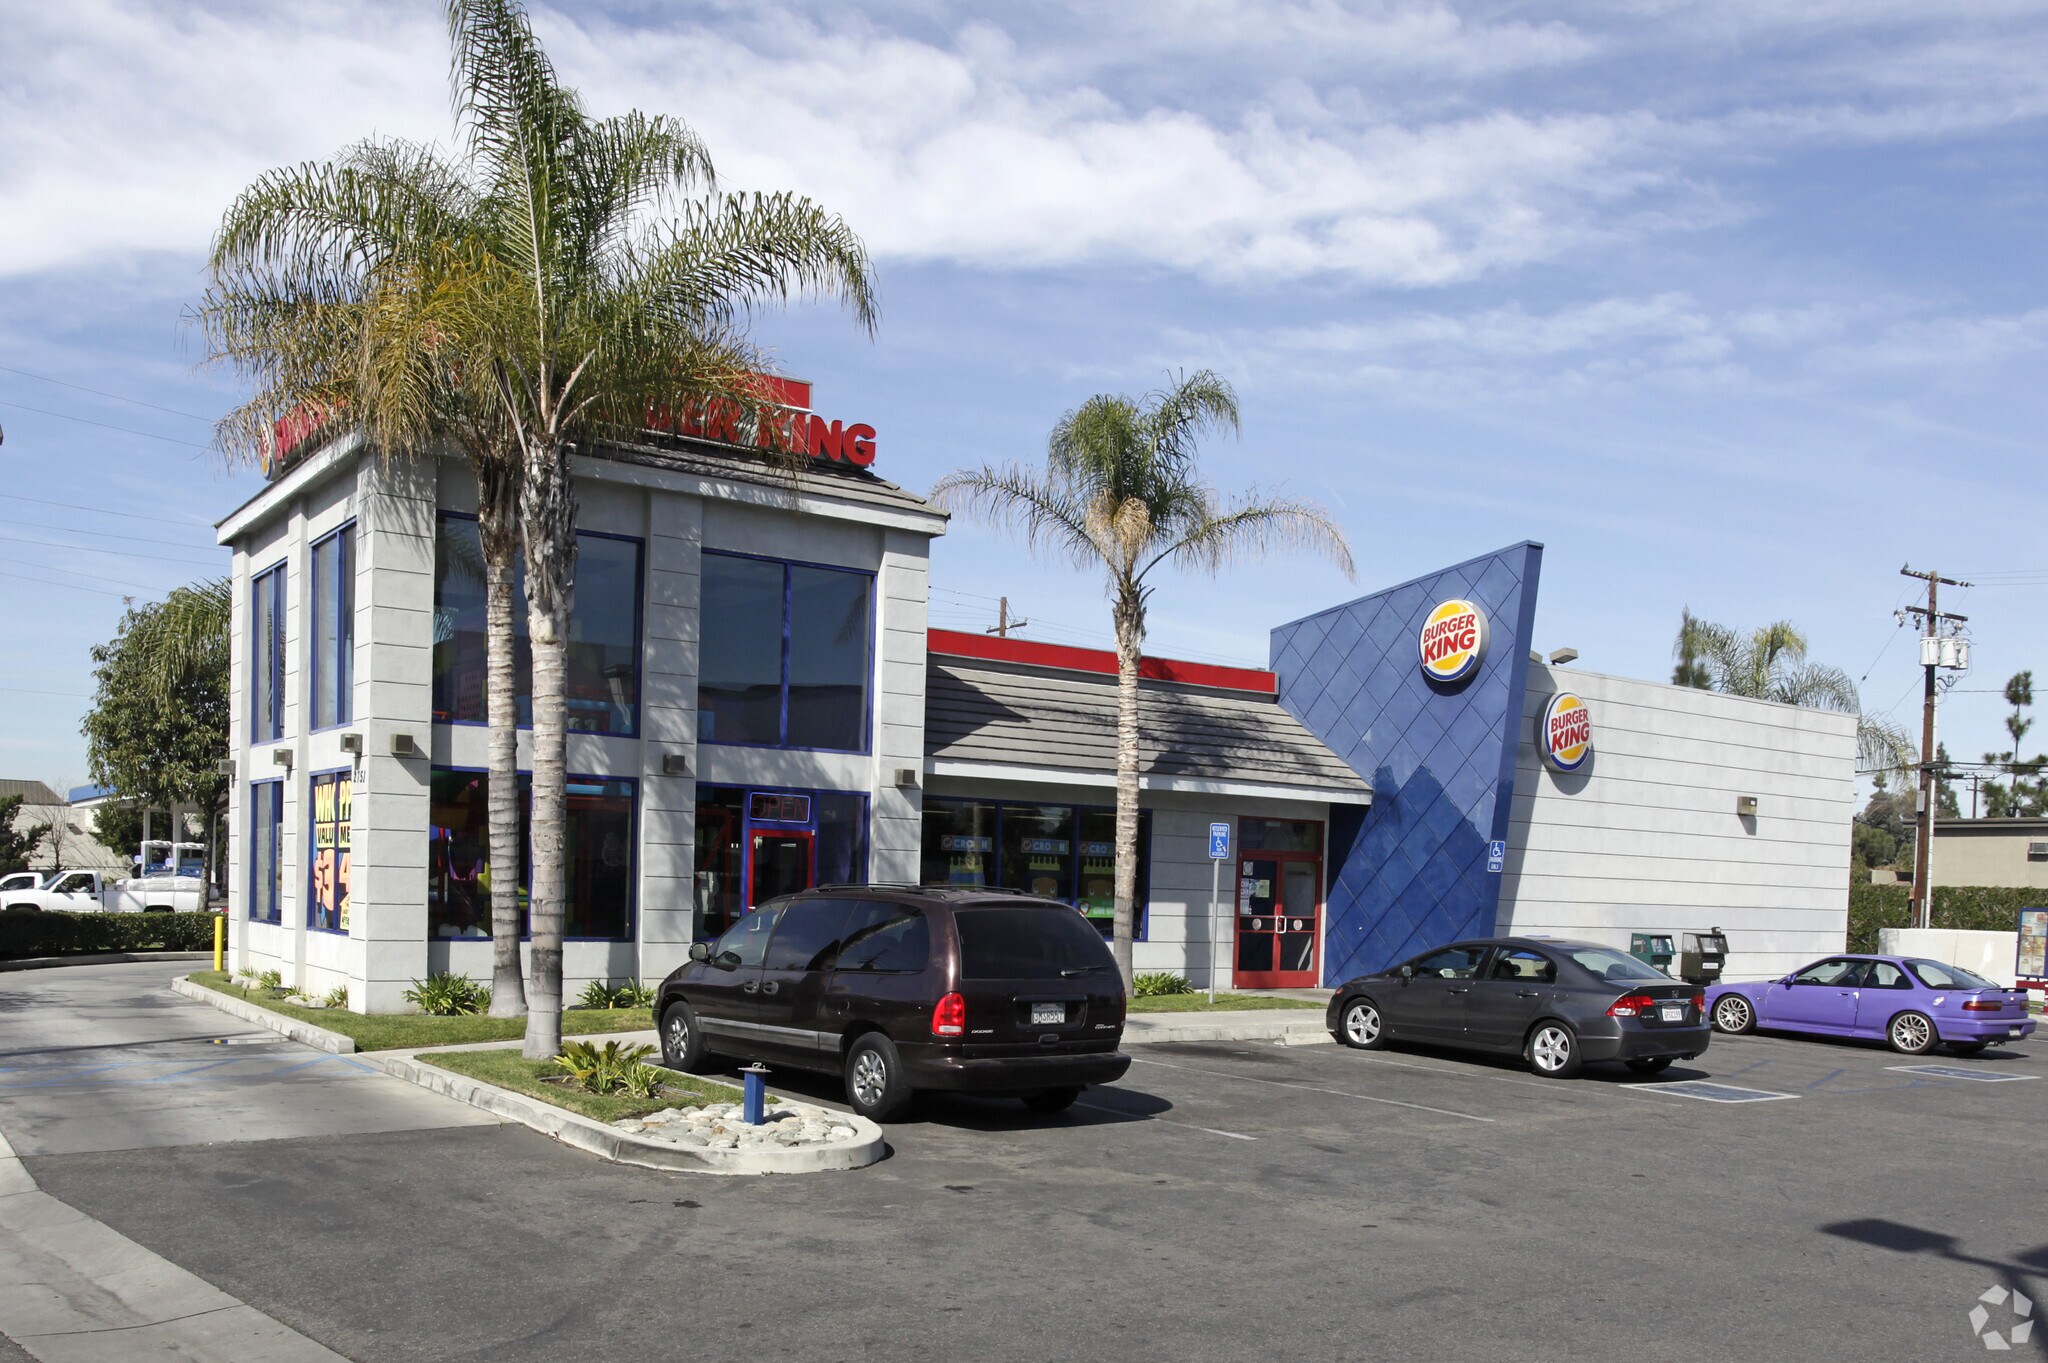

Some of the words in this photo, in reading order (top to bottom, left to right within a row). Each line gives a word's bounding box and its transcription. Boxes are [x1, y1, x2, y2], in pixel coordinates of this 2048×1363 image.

[756, 404, 876, 465] KING
[1423, 614, 1475, 644] BURGER
[1424, 629, 1476, 665] KING
[1551, 709, 1589, 733] BURGER
[1552, 722, 1590, 753] KING
[752, 796, 808, 820] OPEN
